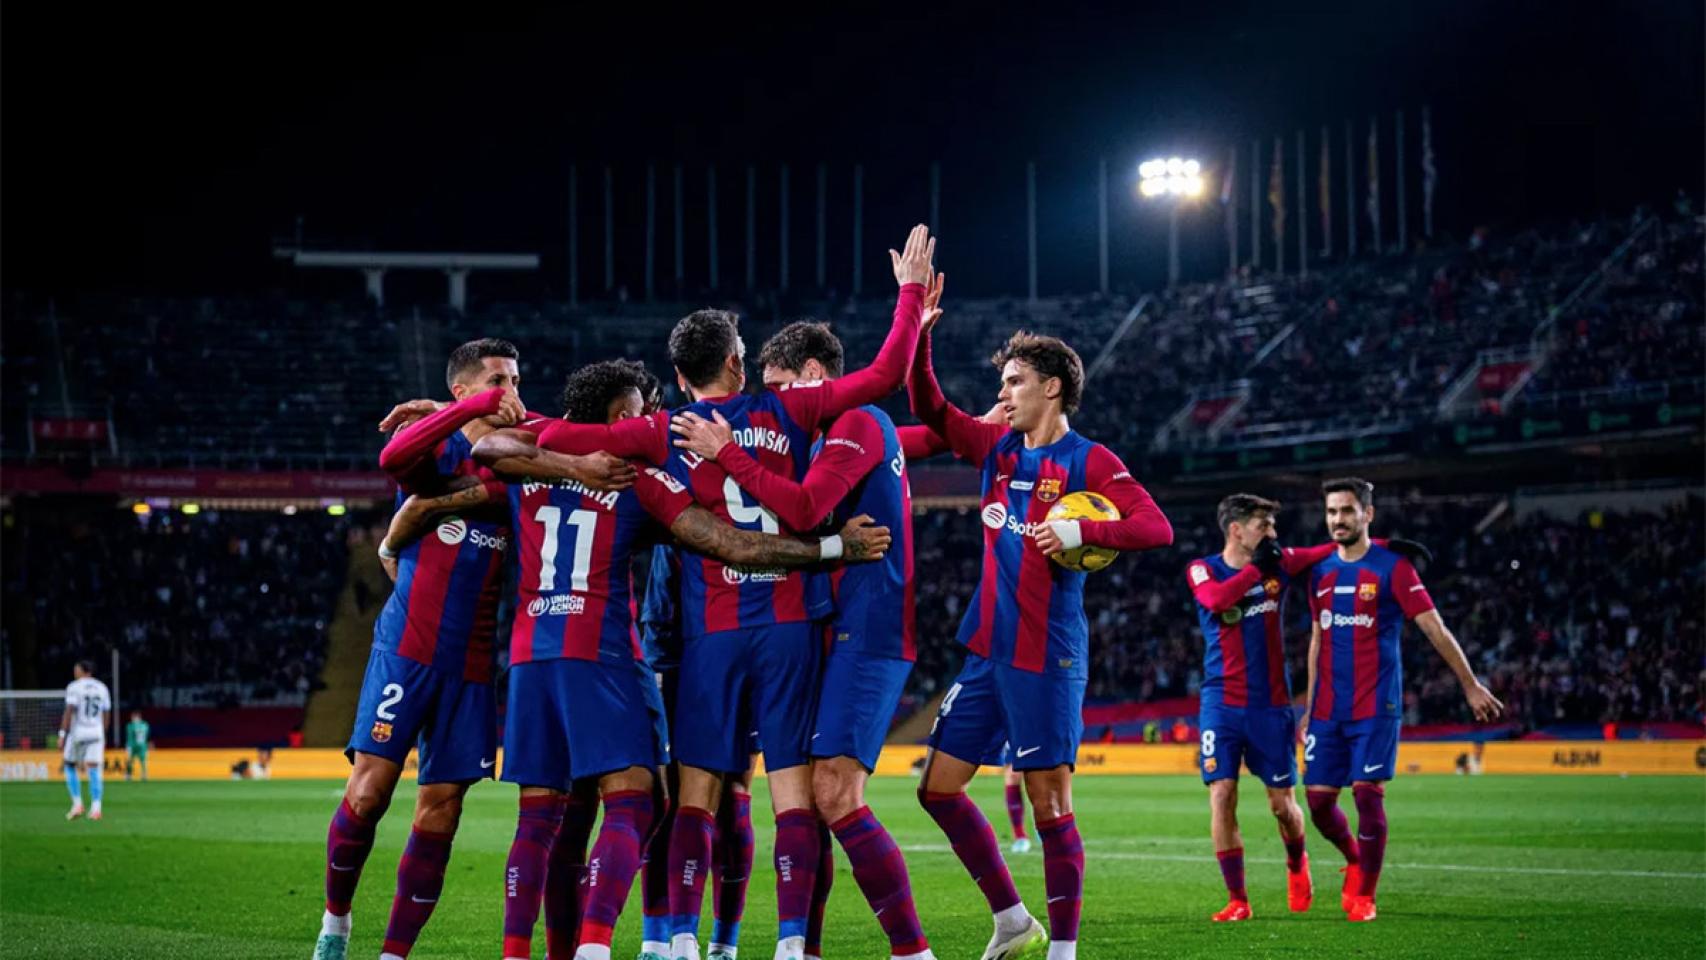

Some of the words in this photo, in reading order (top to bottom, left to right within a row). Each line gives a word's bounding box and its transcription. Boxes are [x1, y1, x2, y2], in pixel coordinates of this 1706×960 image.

[534, 505, 598, 592] 11
[1244, 600, 1279, 618] potify
[1334, 613, 1375, 629] Spotify
[376, 683, 404, 721] 2
[1201, 730, 1217, 756] 8
